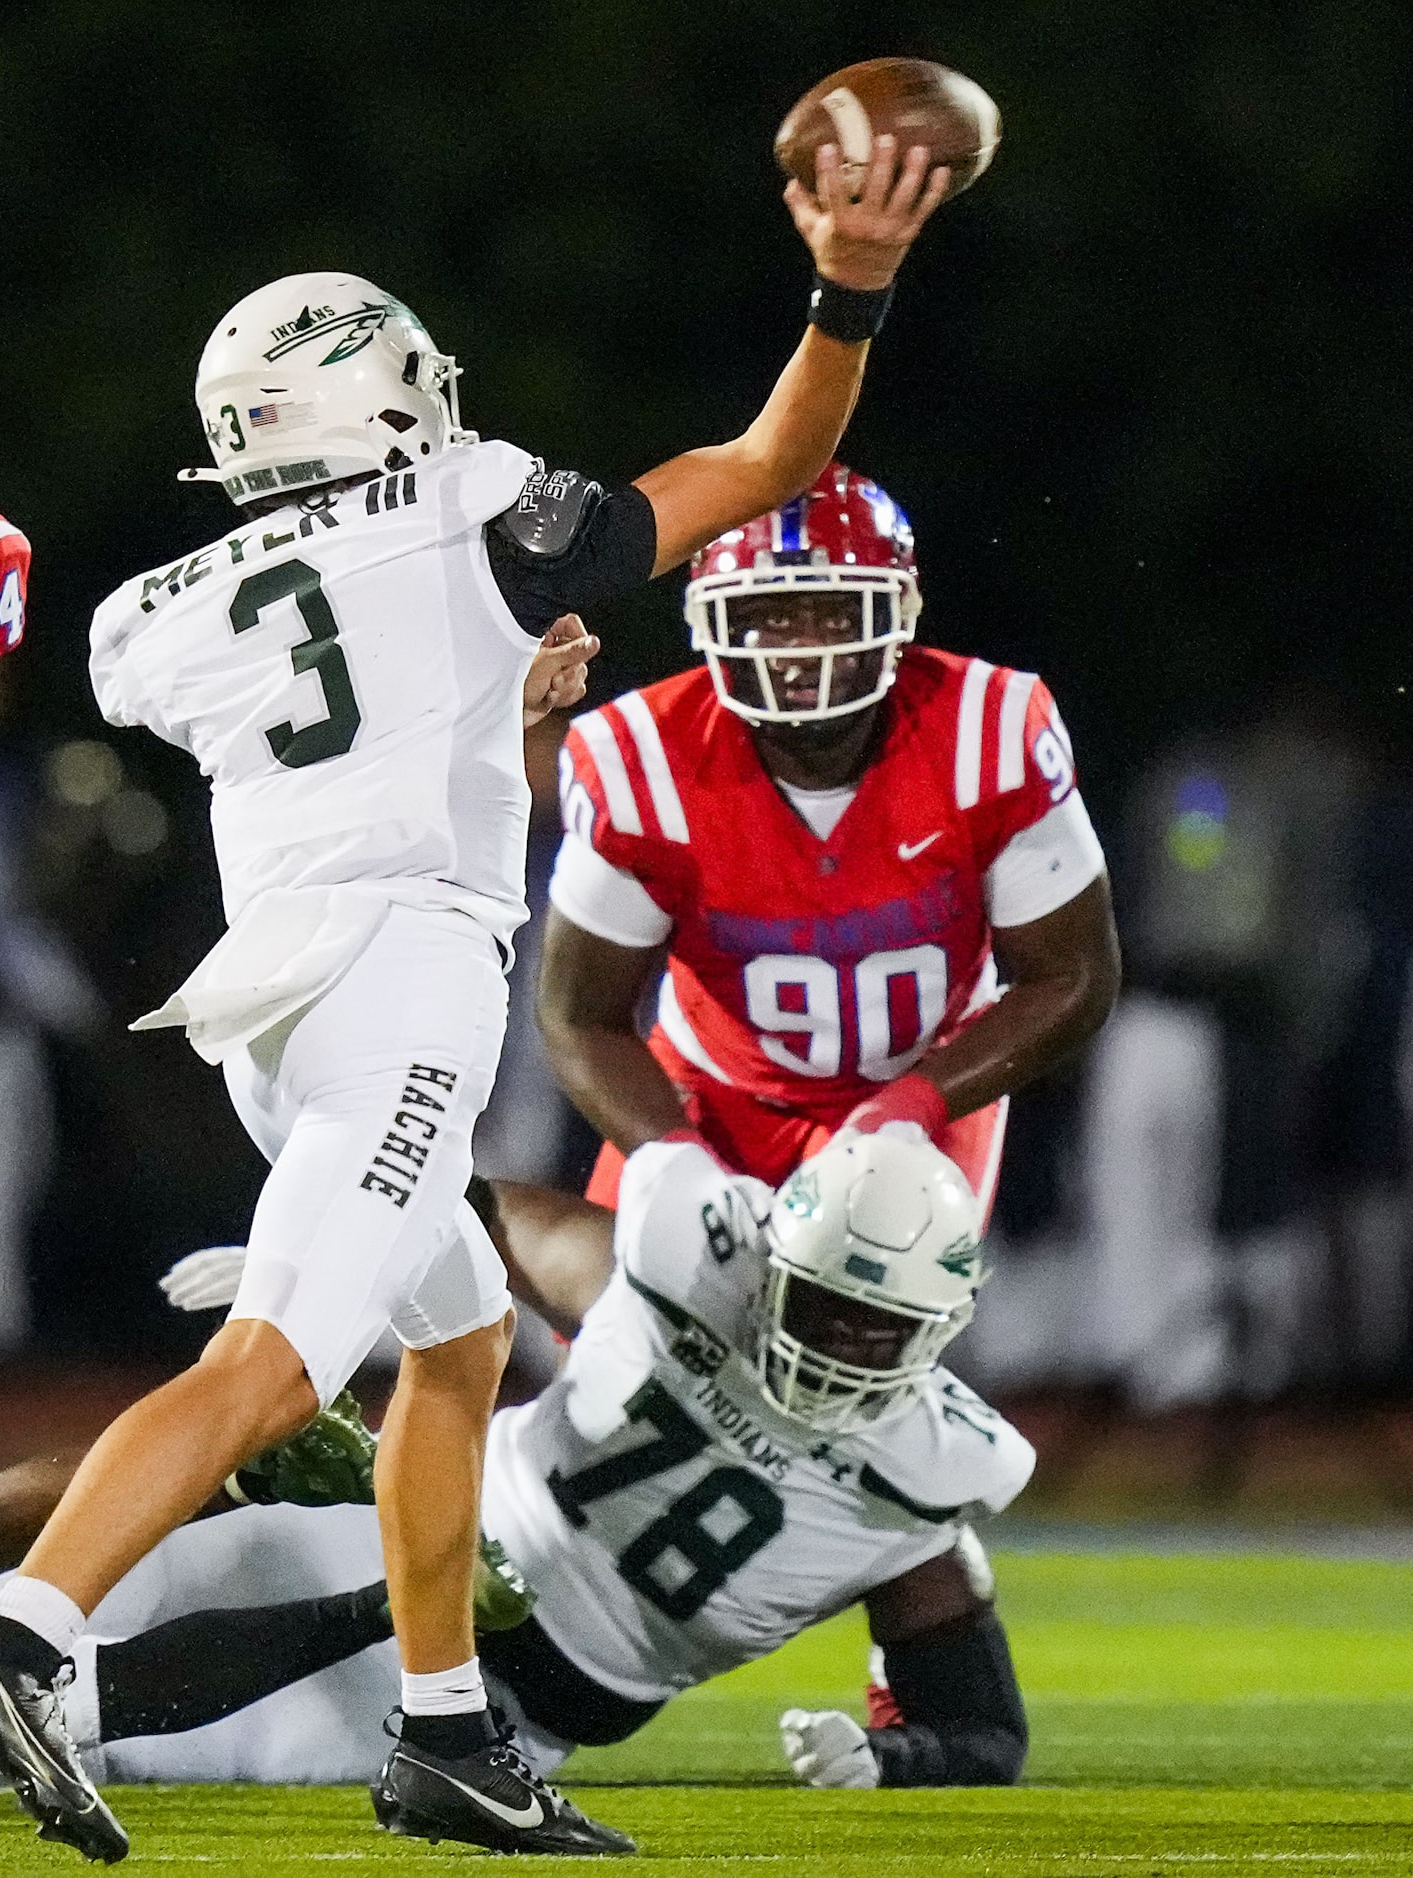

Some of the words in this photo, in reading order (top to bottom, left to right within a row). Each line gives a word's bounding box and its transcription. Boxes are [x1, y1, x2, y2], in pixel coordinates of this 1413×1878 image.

[270, 304, 336, 341] INDNS
[220, 403, 247, 453] 3
[365, 473, 418, 516] III
[228, 558, 361, 770] 3
[742, 943, 949, 1083] 90
[359, 1062, 458, 1210] HACHIE
[696, 1376, 790, 1481] INDIANS
[547, 1376, 786, 1622] 78
